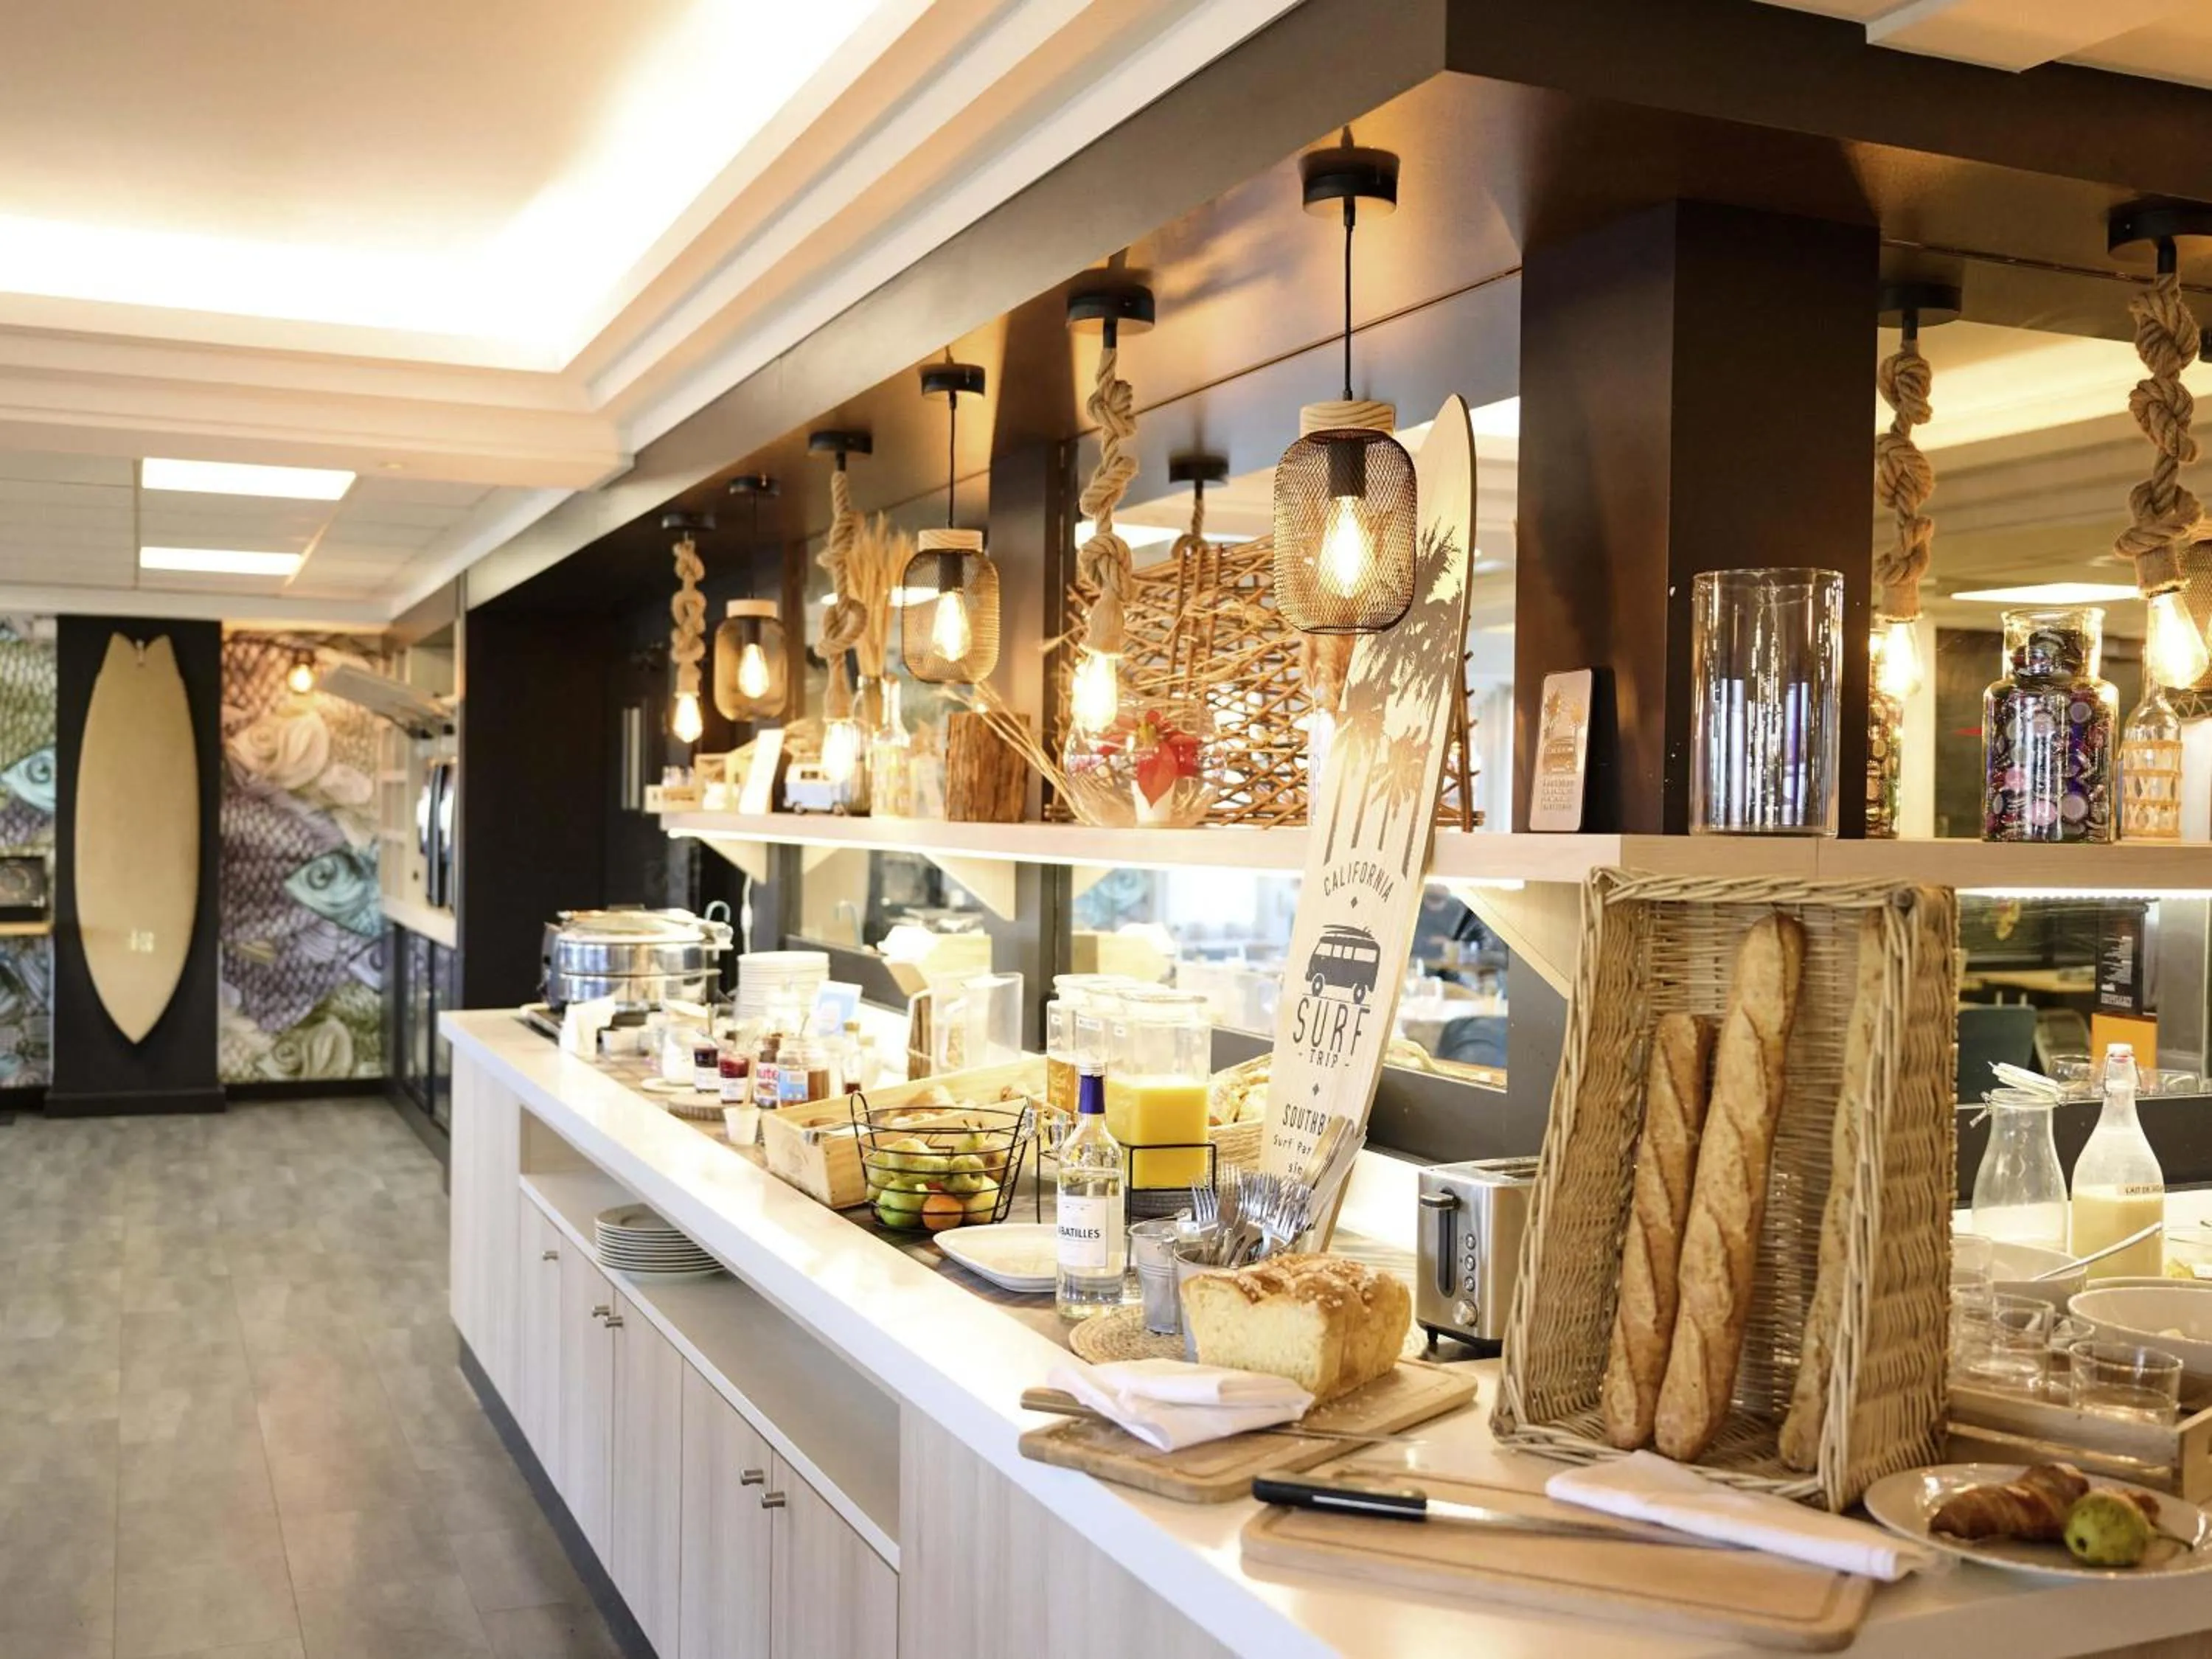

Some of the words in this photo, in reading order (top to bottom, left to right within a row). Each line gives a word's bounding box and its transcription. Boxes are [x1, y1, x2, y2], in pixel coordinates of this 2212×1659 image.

[1324, 860, 1394, 902] CALIFORNIA
[1293, 997, 1371, 1057] SURF
[1309, 1048, 1338, 1068] TRIP
[1273, 1133, 1293, 1148] Surf
